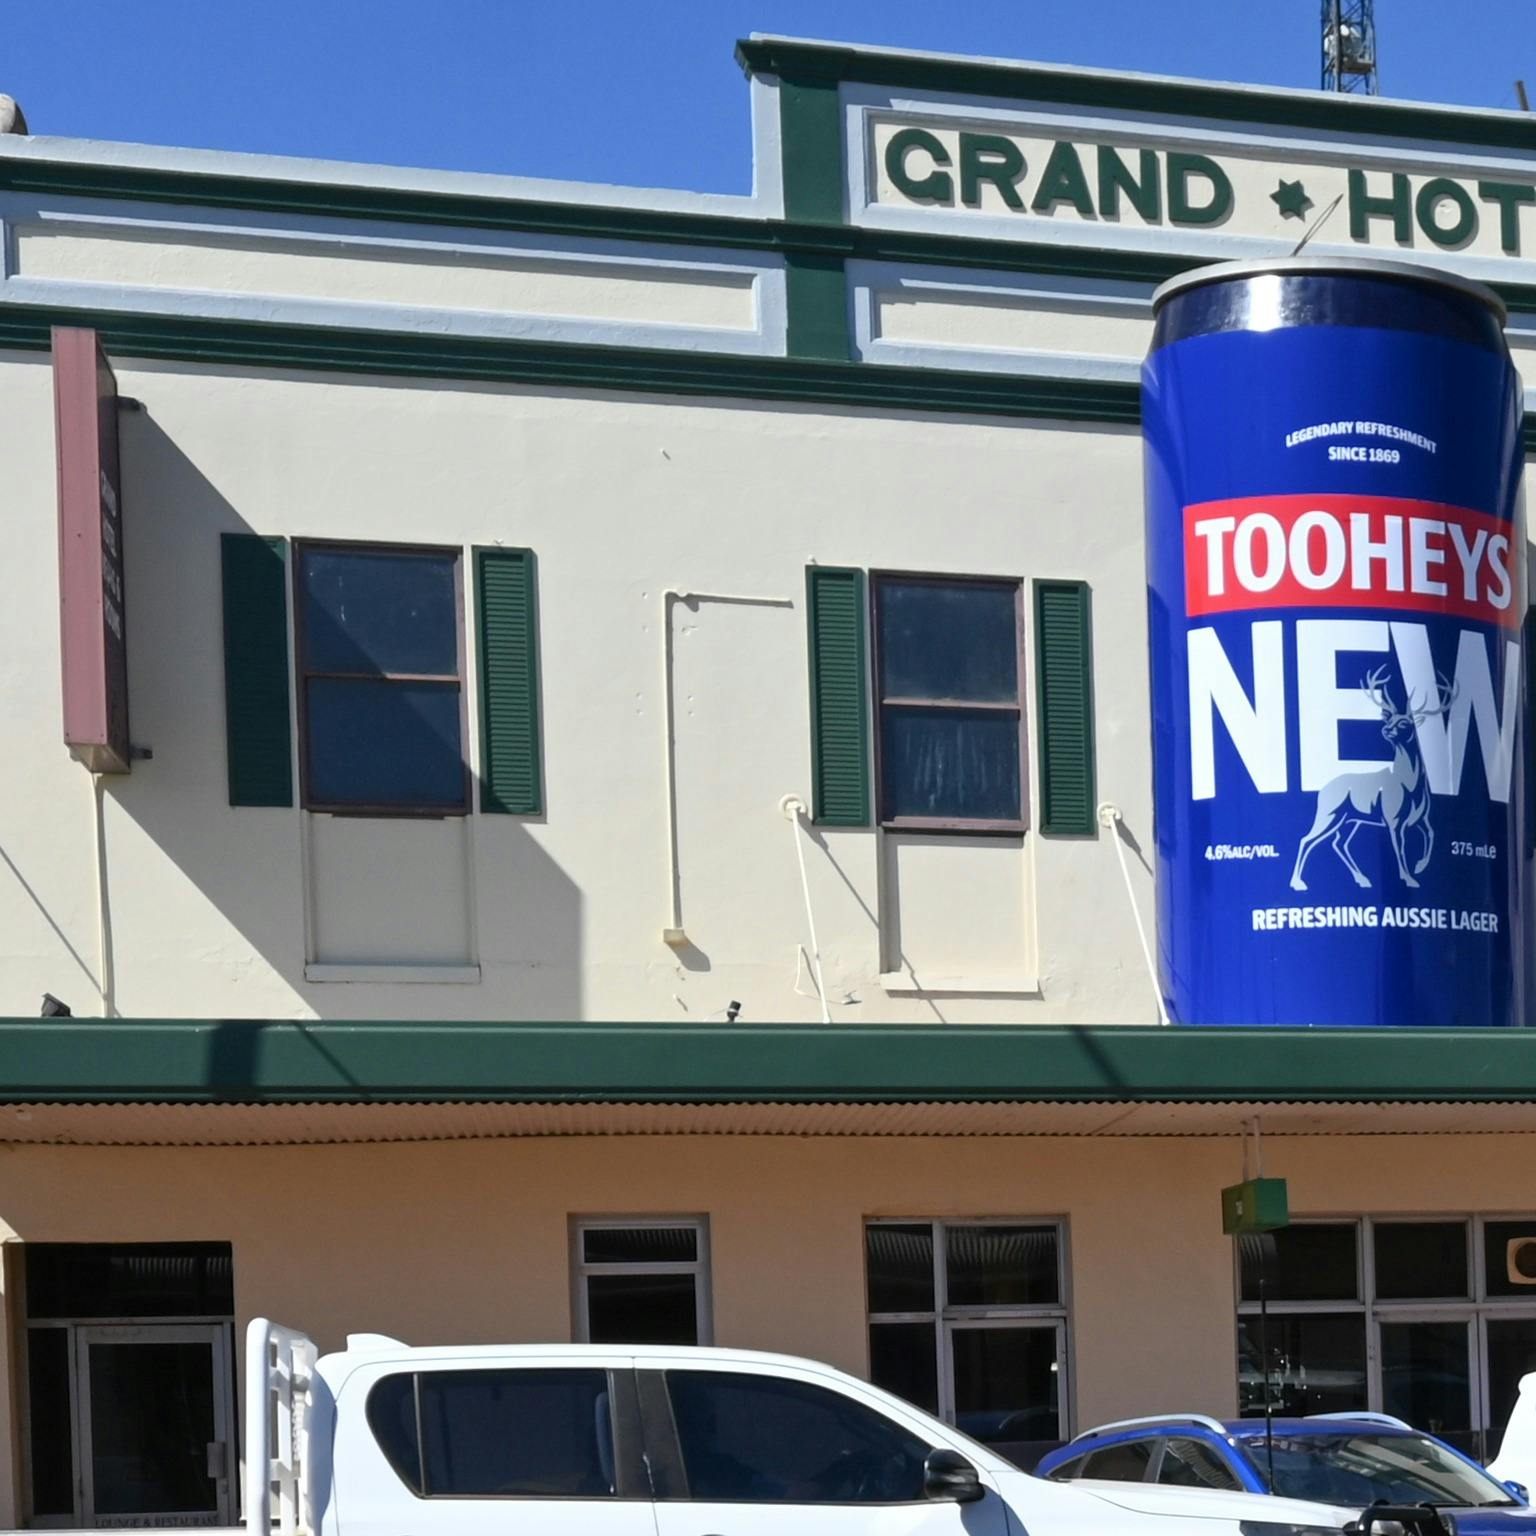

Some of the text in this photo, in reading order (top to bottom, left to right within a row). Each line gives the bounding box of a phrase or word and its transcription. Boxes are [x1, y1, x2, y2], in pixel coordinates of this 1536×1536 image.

[885, 128, 1236, 230] GRAND
[1285, 421, 1437, 453] LEGENDARY REFRESHMENT
[1328, 446, 1400, 464] SINCE 1869
[1194, 510, 1513, 610] TOOHEYS
[1187, 618, 1520, 804] NEW
[1451, 841, 1473, 856] 375
[1252, 906, 1499, 933] REFRESHING AUSSIE LAGER
